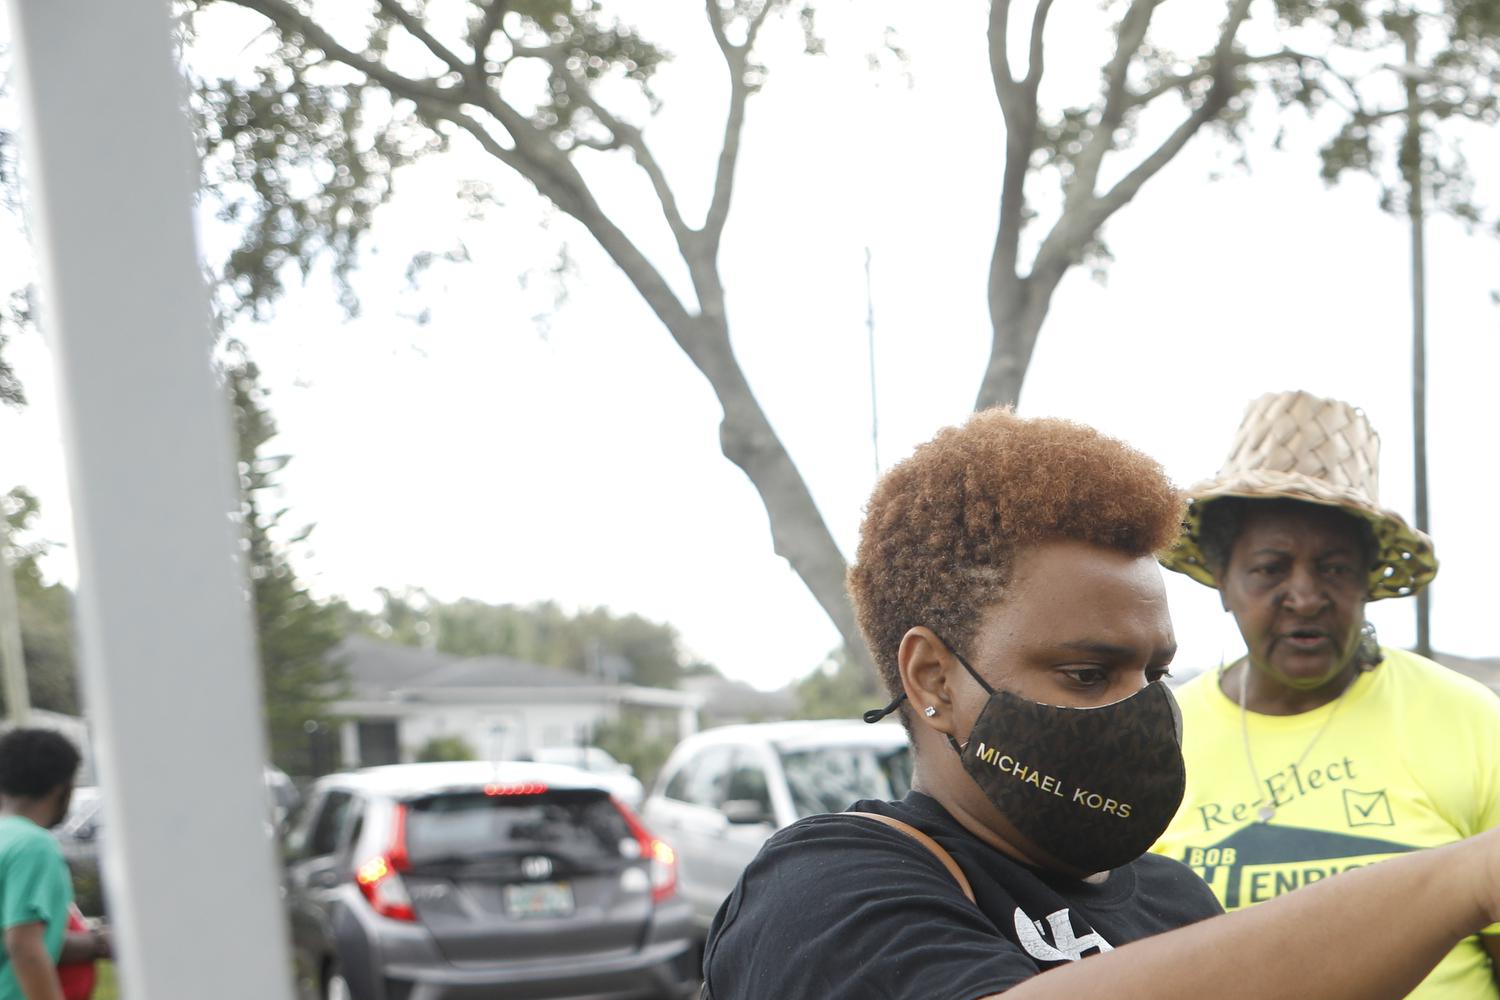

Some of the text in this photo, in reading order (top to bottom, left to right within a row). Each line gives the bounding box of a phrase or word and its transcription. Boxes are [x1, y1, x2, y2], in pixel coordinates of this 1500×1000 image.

[976, 743, 1132, 818] MICHAEL KORS
[1198, 757, 1357, 832] Re-Elect
[1189, 847, 1237, 867] BOB
